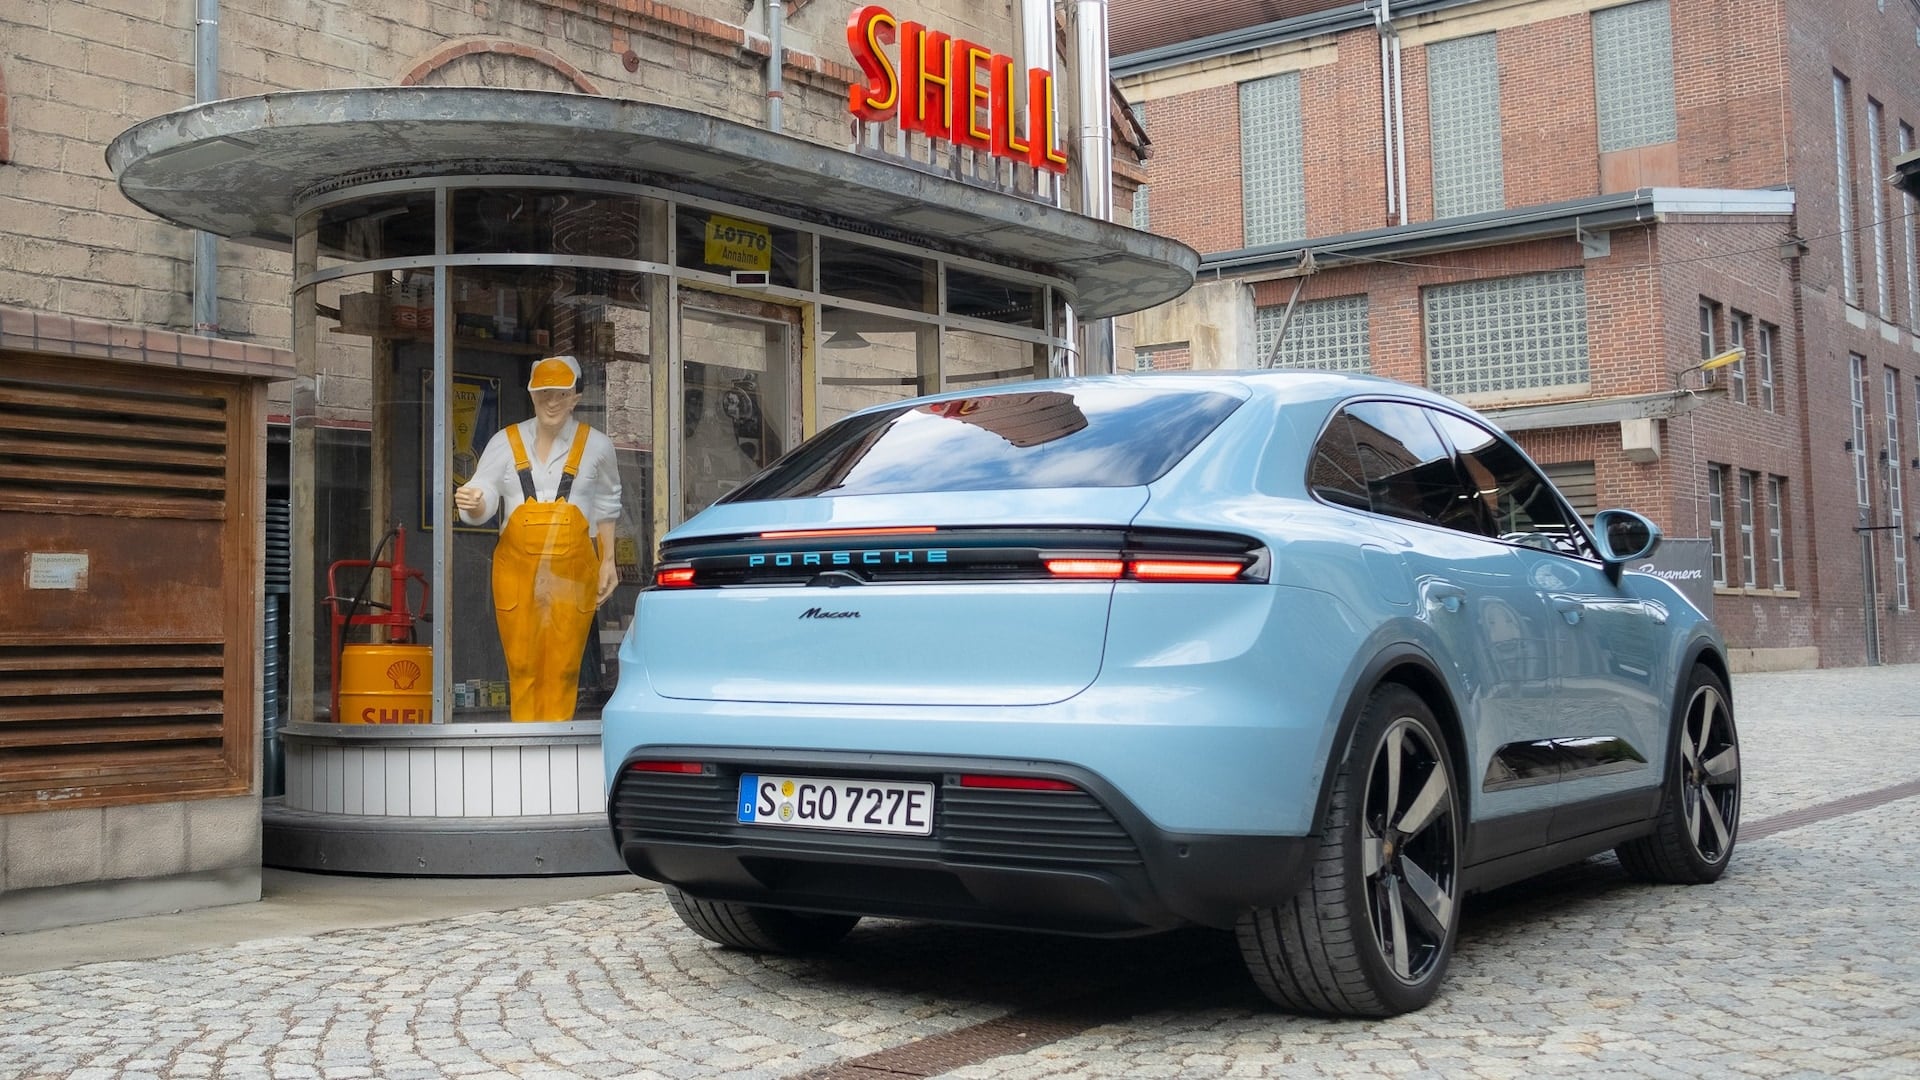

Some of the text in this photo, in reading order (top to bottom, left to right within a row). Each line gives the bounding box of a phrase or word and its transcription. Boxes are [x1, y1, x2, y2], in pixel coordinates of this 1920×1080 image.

[847, 5, 1067, 174] SHELL
[713, 224, 767, 251] LOTTO
[722, 246, 758, 265] Annahme
[454, 390, 477, 401] ARTA
[749, 550, 948, 567] PORSCHE
[799, 607, 861, 620] Macan
[362, 708, 433, 725] SHE
[744, 803, 752, 814] D
[758, 782, 925, 827] S GO 727E
